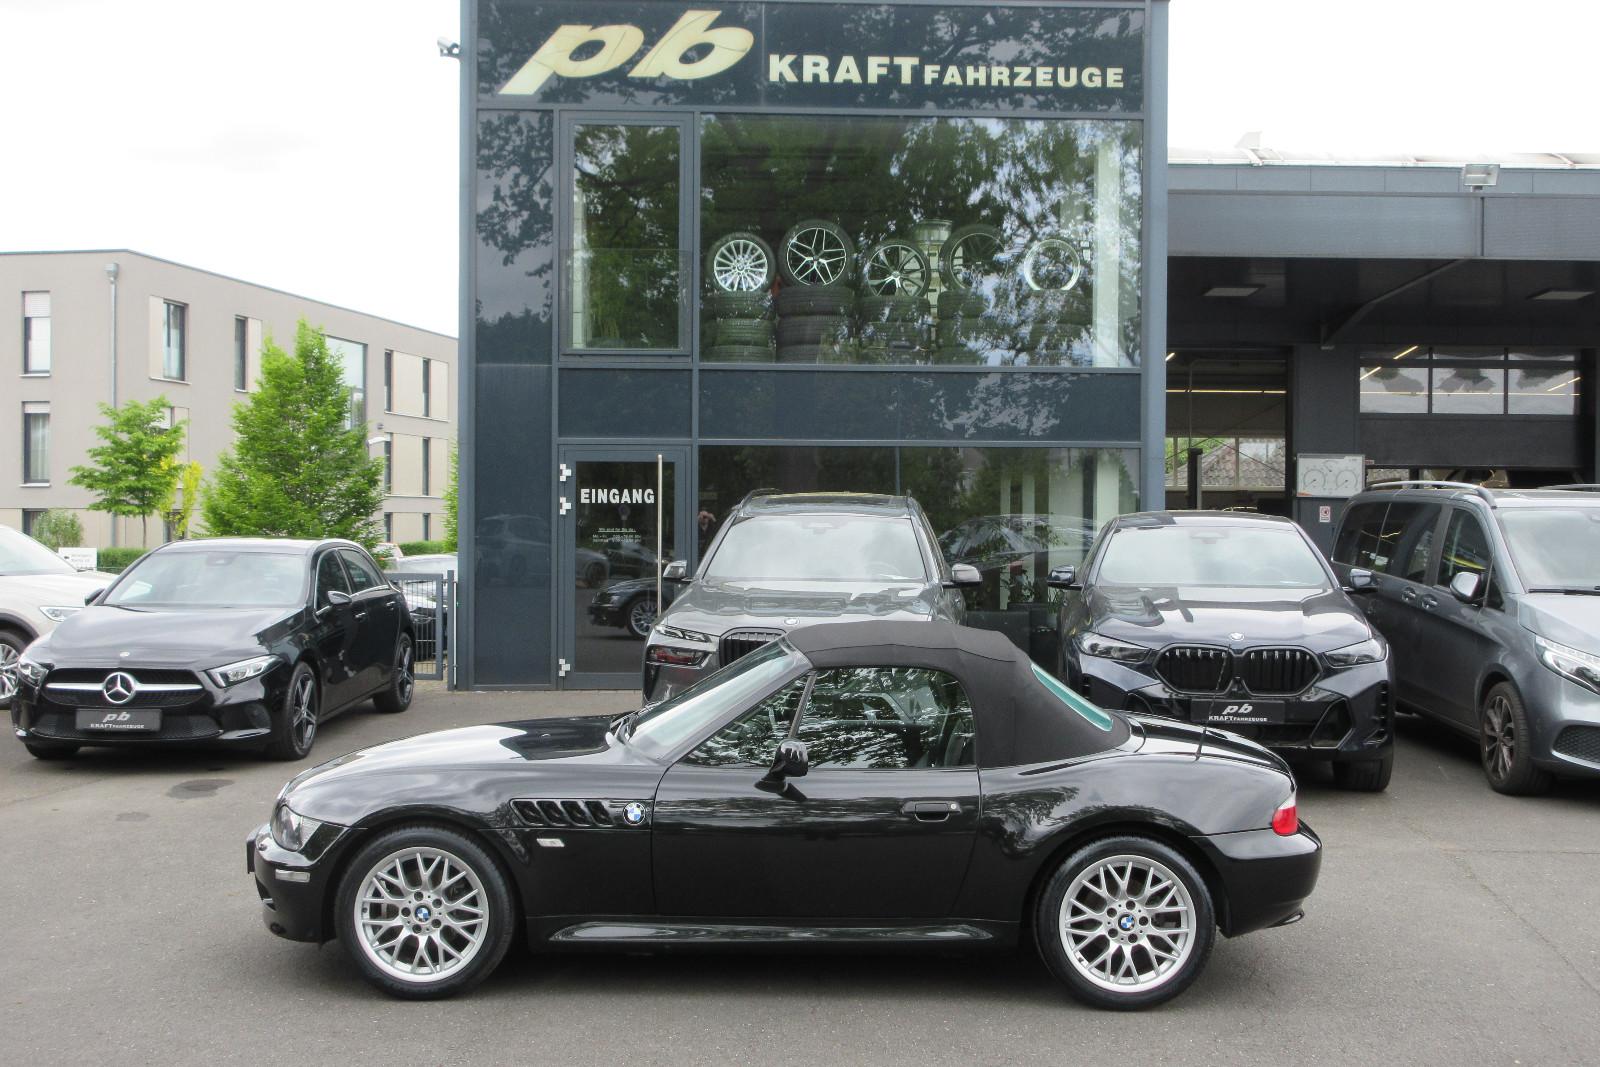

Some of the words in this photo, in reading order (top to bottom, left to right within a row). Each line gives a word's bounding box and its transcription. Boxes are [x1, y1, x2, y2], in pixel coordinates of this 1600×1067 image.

[499, 10, 754, 95] pb
[769, 54, 1124, 88] KRAFTFAHRZEUGE
[580, 488, 655, 503] EINGANG
[1222, 703, 1253, 714] pb
